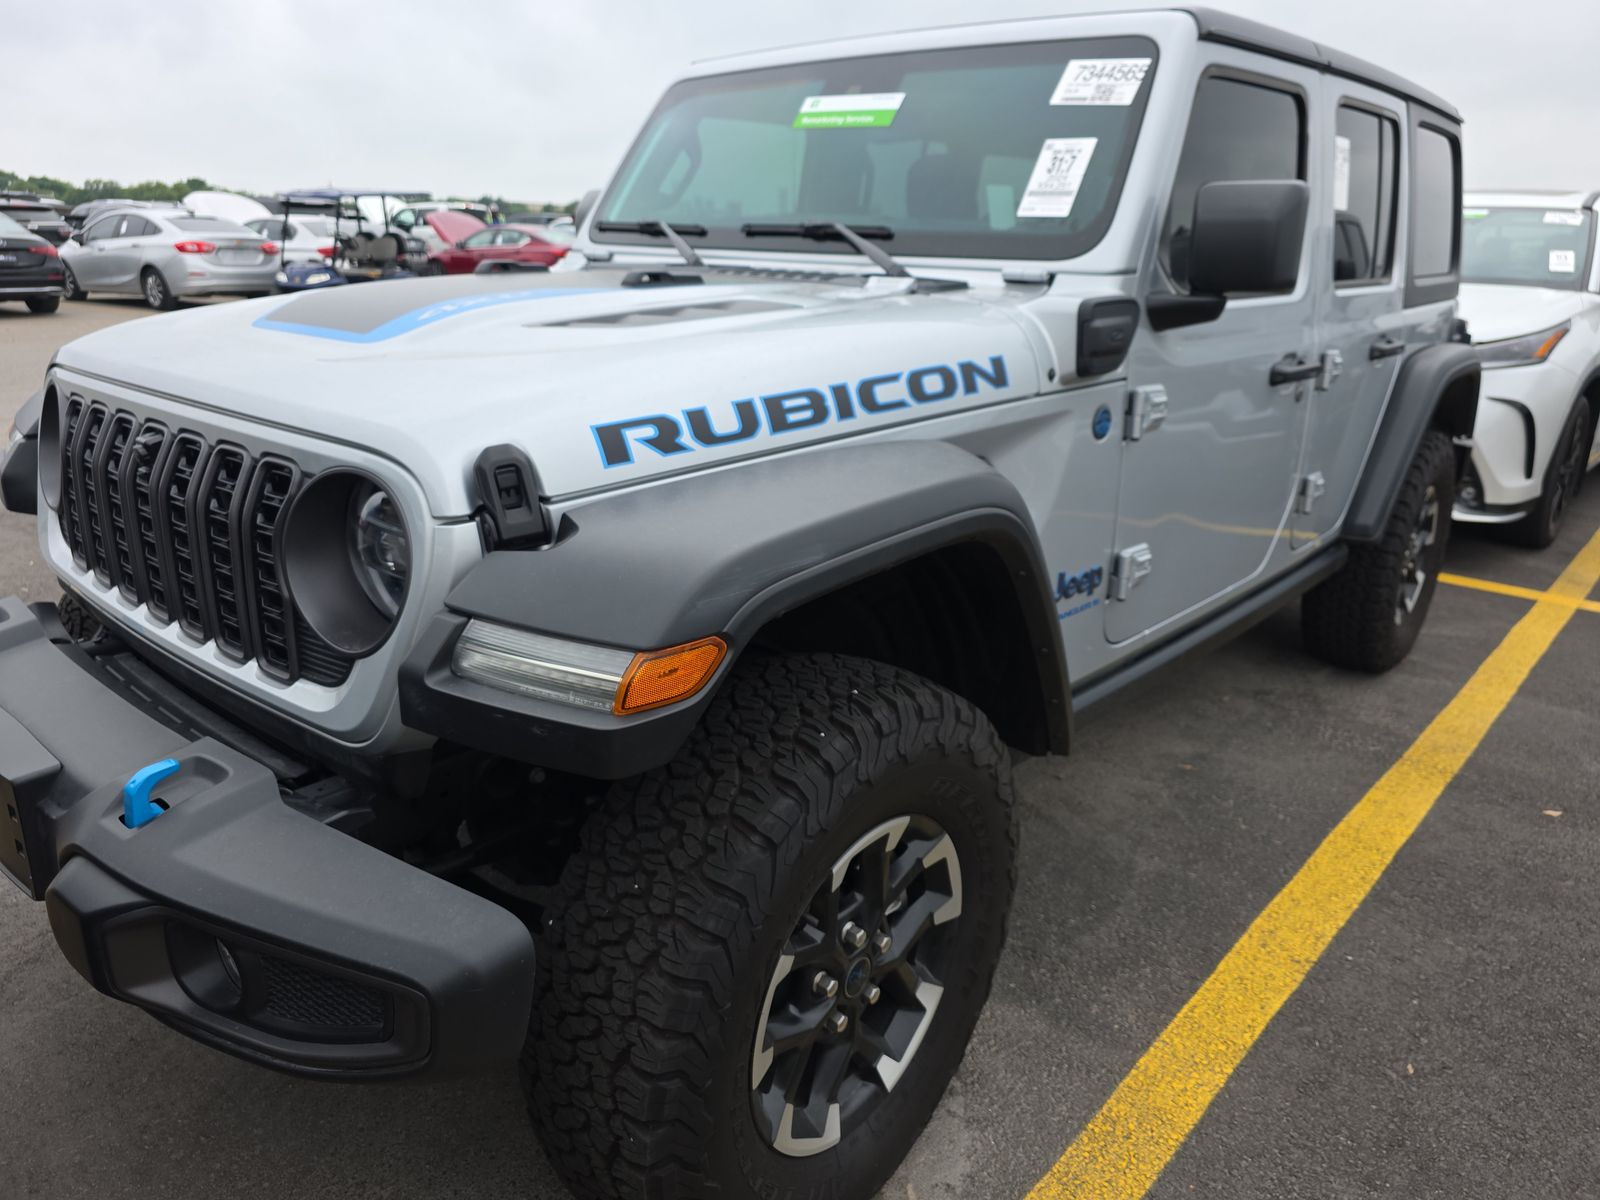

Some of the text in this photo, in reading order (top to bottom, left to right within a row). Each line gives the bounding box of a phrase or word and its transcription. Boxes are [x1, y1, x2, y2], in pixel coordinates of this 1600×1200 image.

[1074, 63, 1149, 82] 7344565
[590, 354, 1010, 469] RUBICON
[1054, 566, 1103, 603] Jeep
